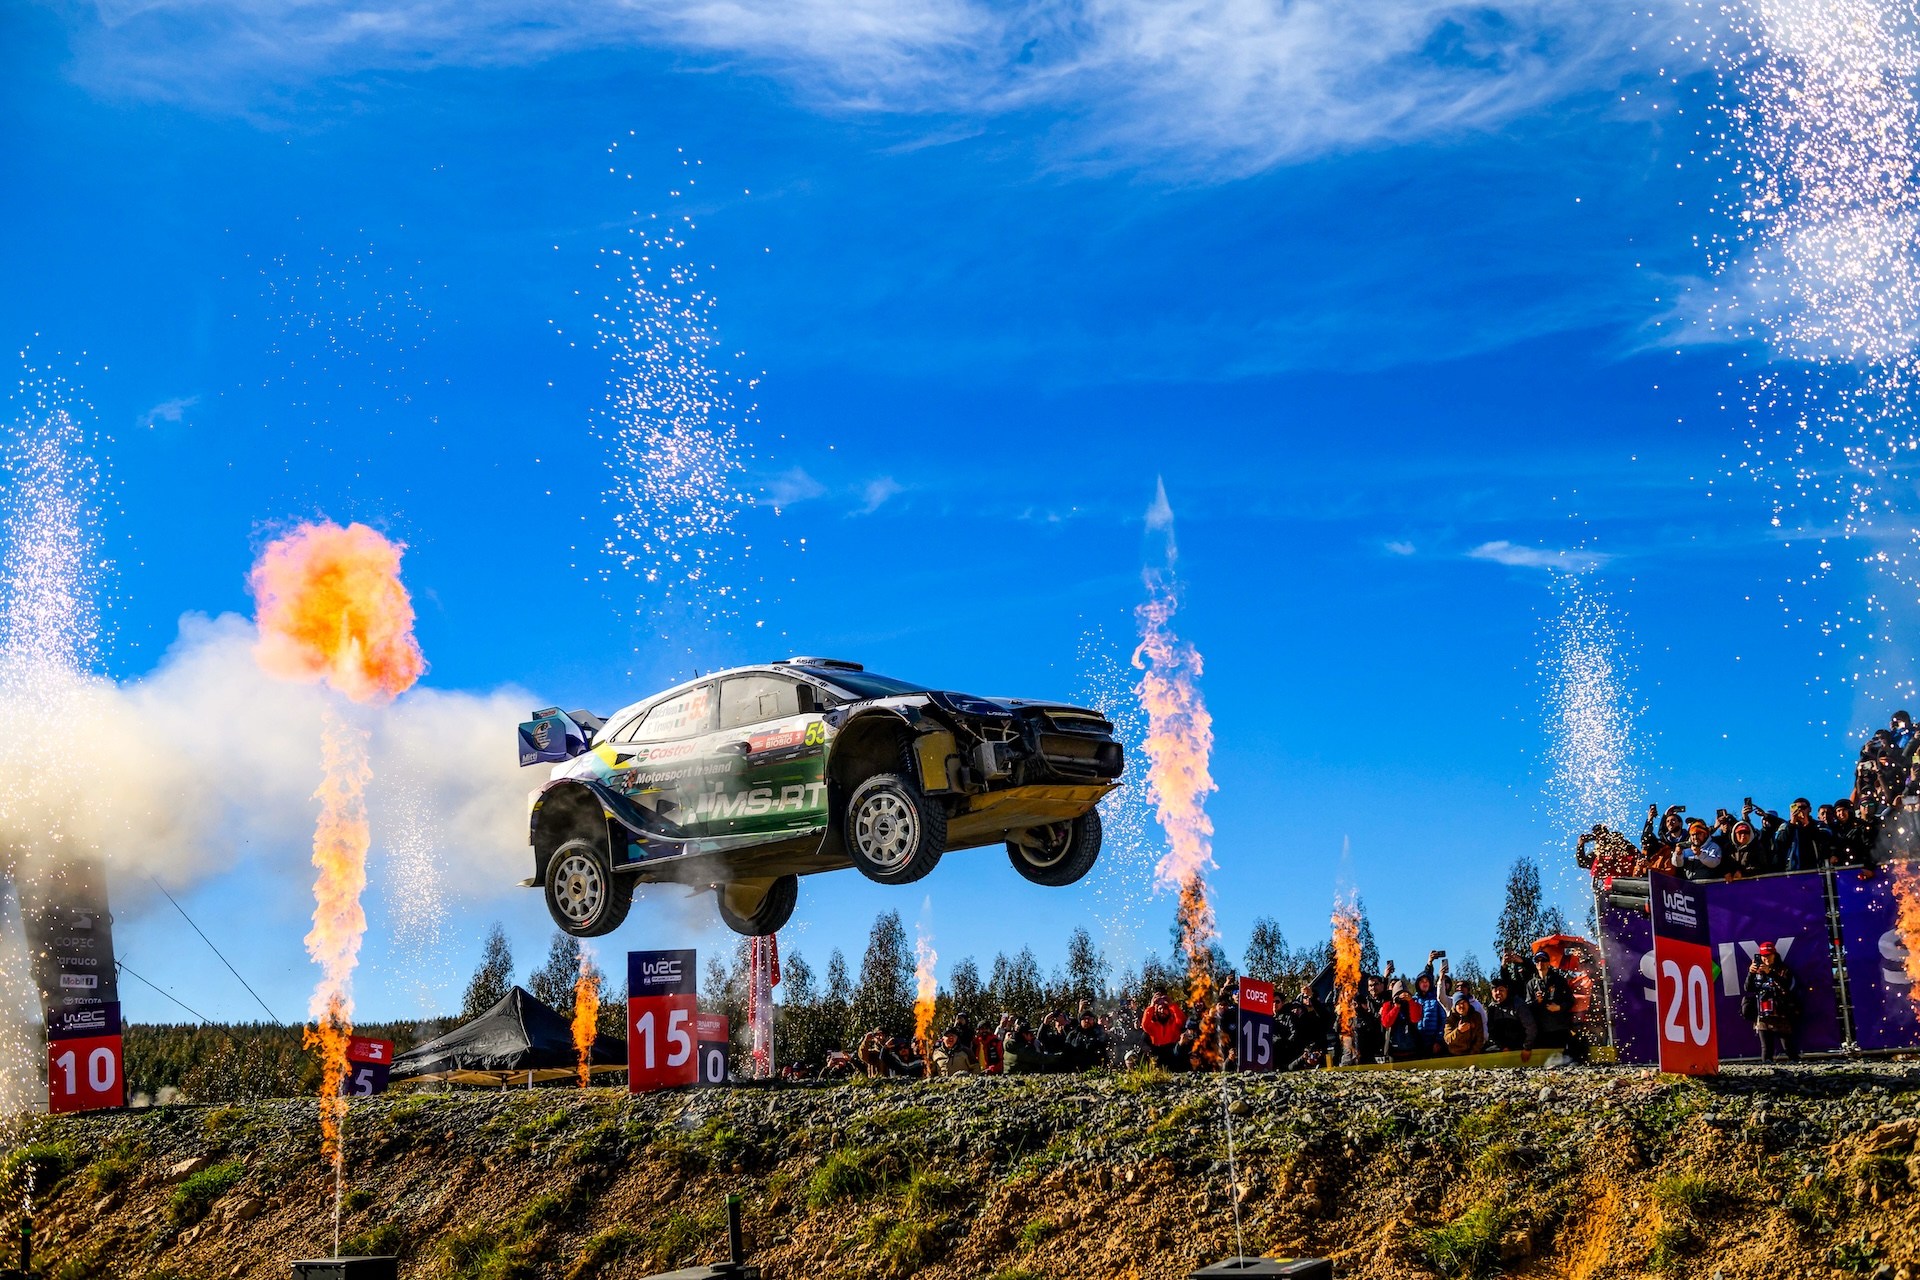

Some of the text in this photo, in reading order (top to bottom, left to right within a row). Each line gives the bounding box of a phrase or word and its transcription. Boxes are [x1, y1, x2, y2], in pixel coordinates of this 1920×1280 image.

[649, 742, 698, 760] Castrol
[635, 760, 733, 784] Motorsport Ireland
[1663, 890, 1696, 914] WRC
[55, 937, 95, 948] COPEC
[59, 957, 98, 967] arauco
[643, 961, 682, 975] WRC
[63, 976, 85, 986] Mobil
[1245, 989, 1268, 1004] COPEC
[1663, 960, 1711, 1047] 20
[64, 1010, 105, 1023] WRC
[635, 1009, 691, 1069] 15
[1242, 1020, 1271, 1065] 15
[55, 1047, 116, 1096] 10
[355, 1069, 374, 1096] 5
